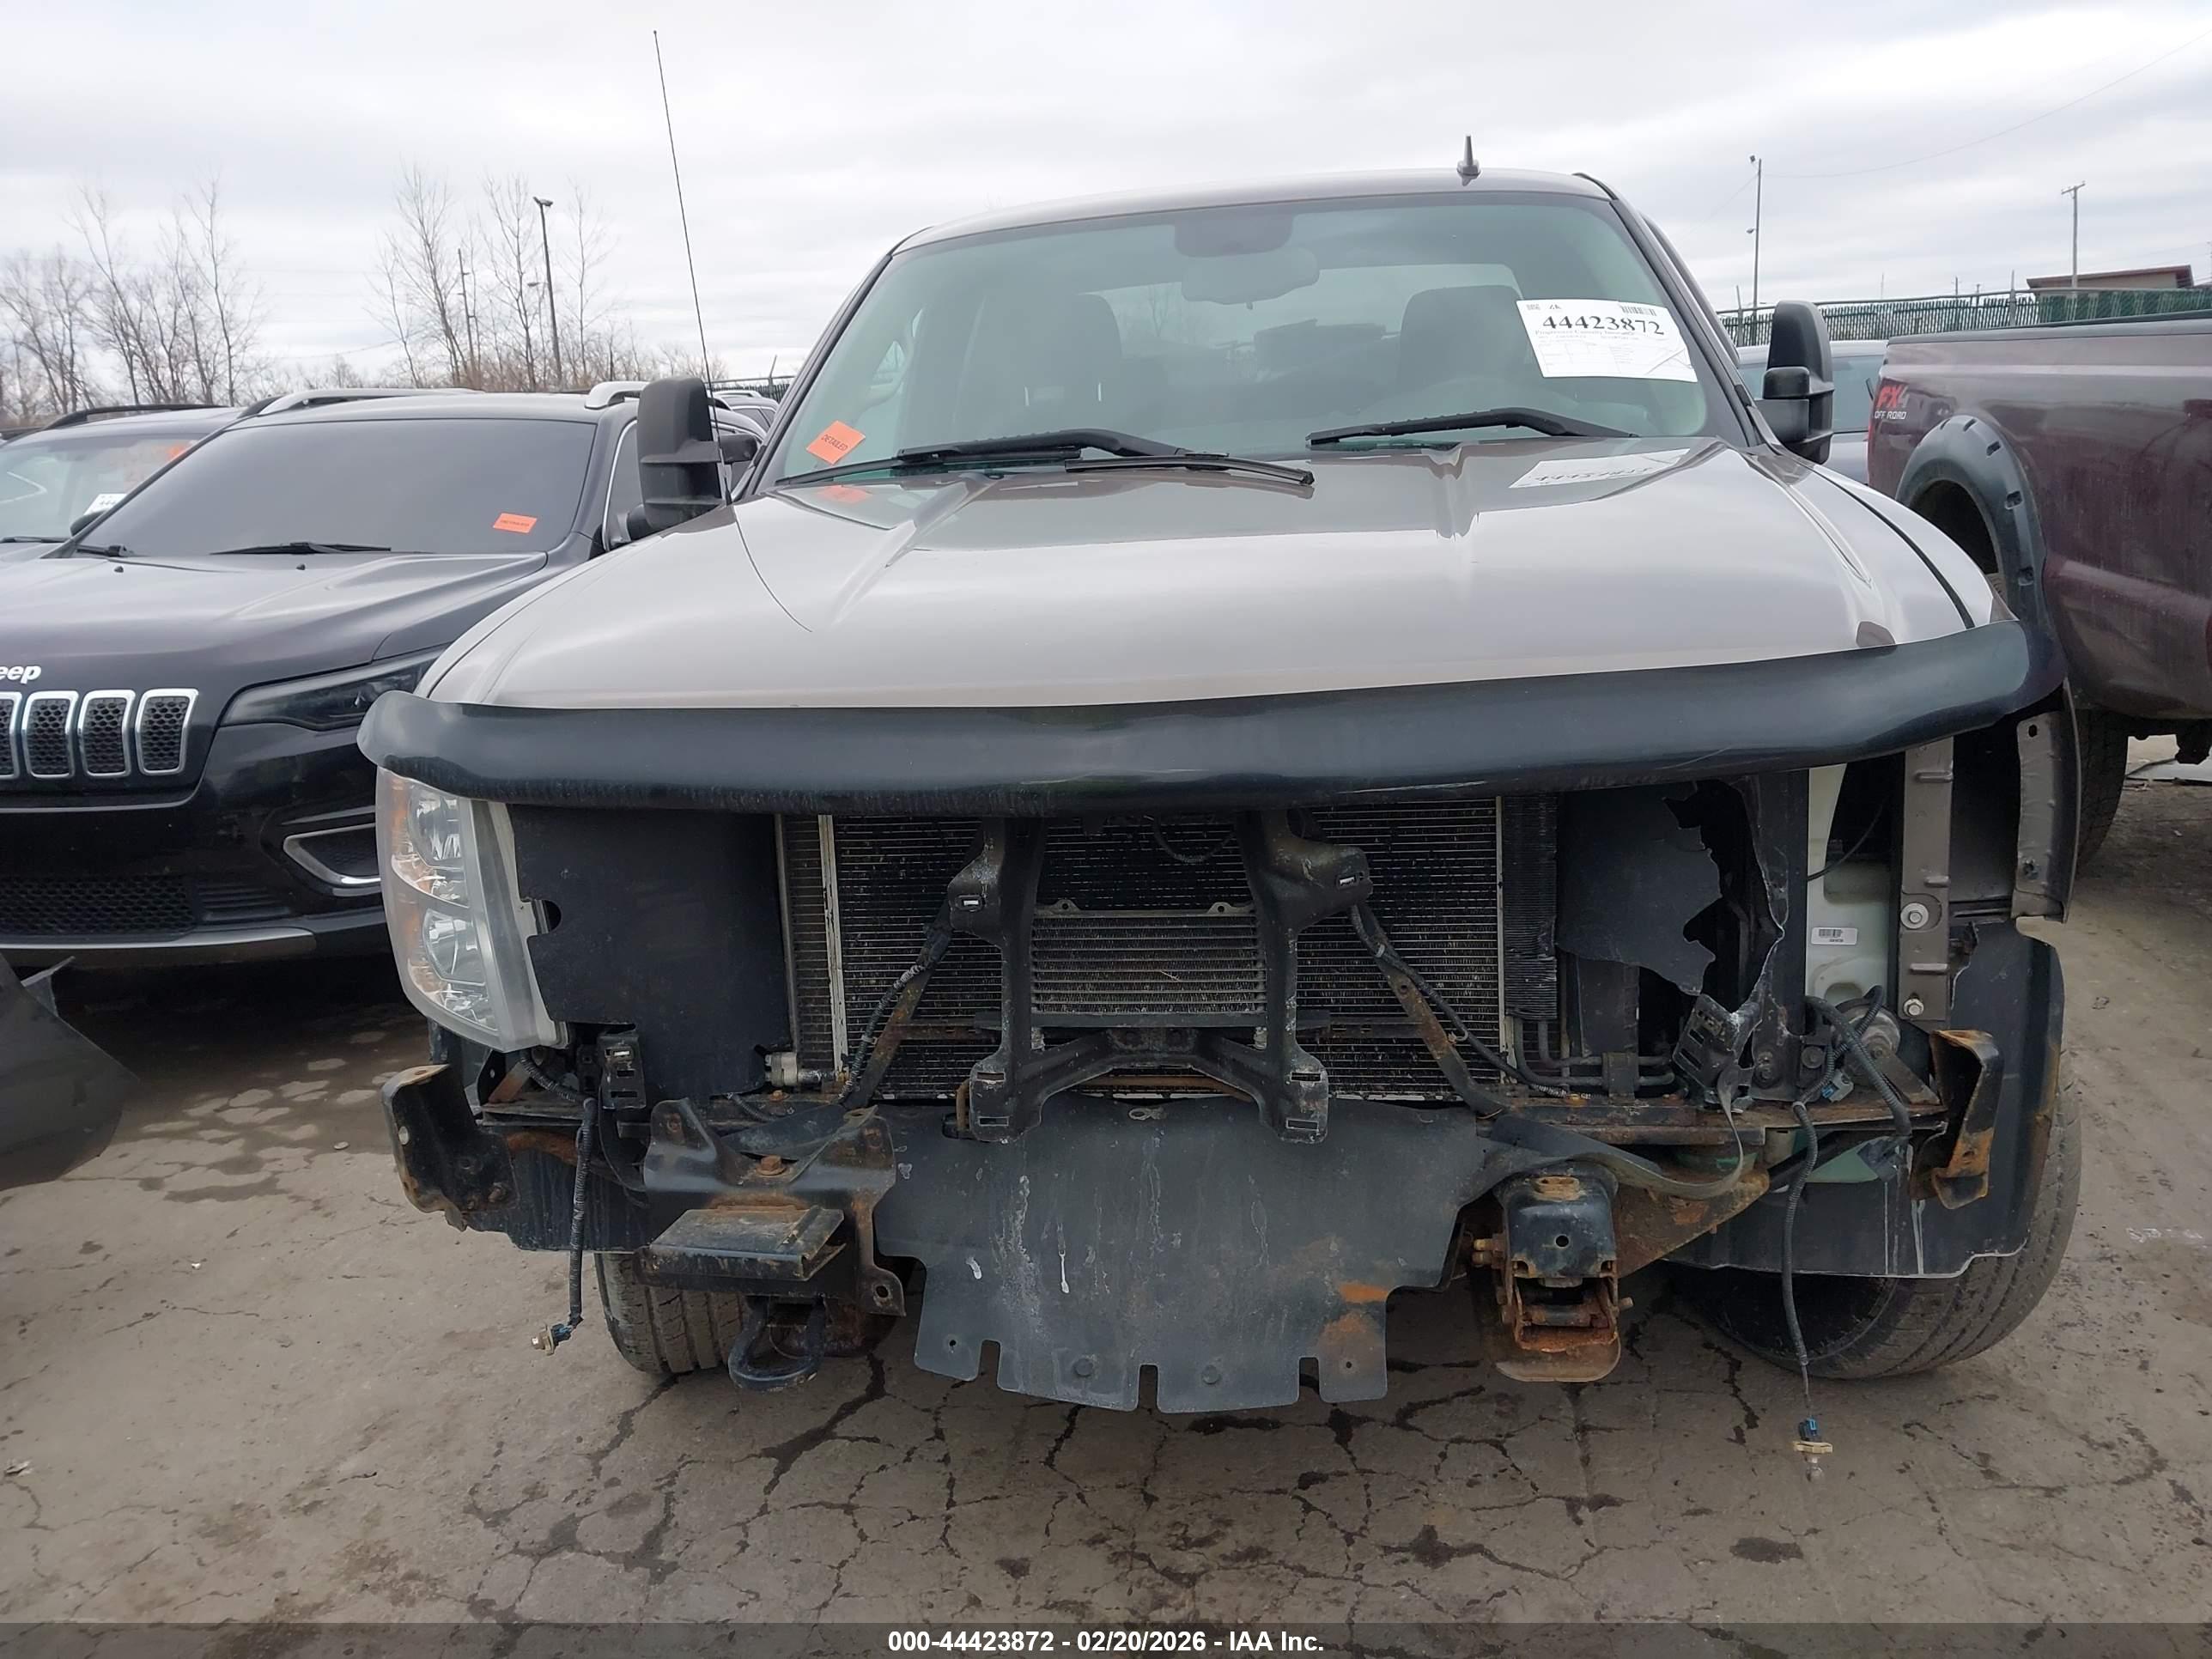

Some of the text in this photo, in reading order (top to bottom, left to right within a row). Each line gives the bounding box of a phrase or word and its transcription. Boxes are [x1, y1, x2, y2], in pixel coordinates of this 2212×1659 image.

[1542, 315, 1665, 336] 44423872
[1876, 386, 1910, 409] FX4
[1875, 410, 1907, 420] OFF ROAD
